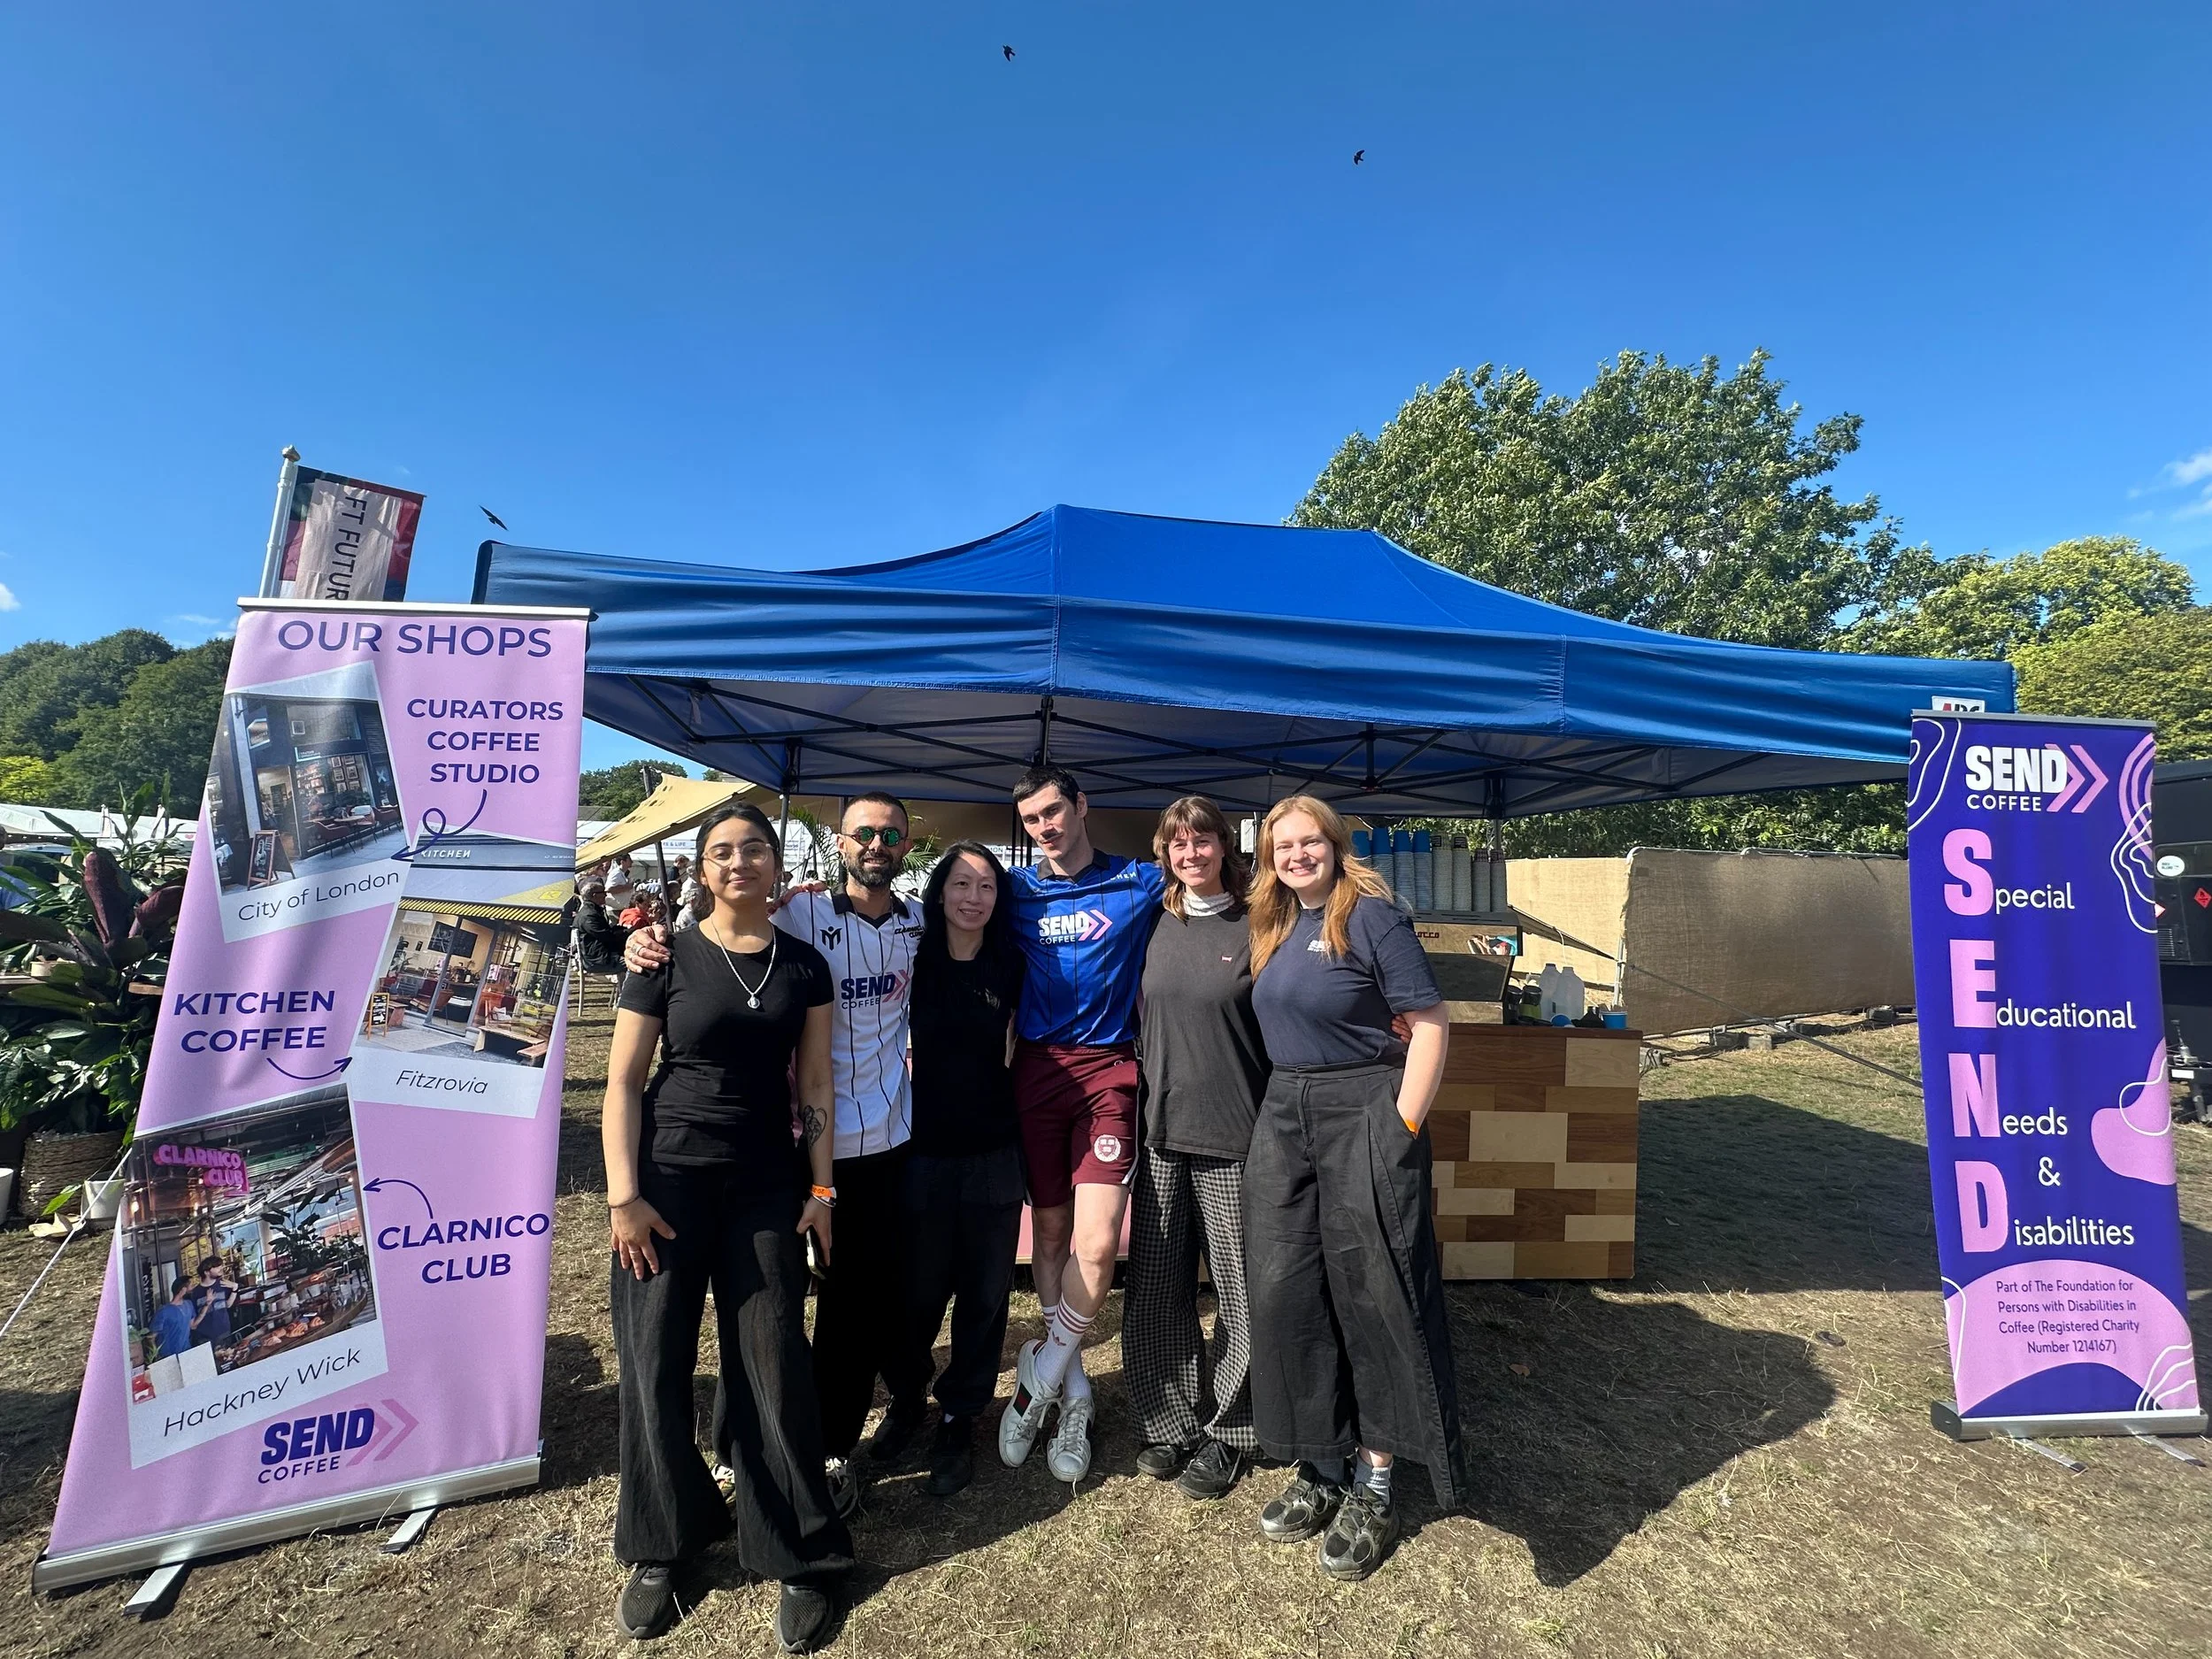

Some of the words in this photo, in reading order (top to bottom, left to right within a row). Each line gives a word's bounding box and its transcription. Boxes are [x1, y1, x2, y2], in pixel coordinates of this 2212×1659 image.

[342, 496, 367, 525] FT
[278, 620, 382, 652] OUR
[397, 624, 551, 657] SHOPS
[407, 699, 564, 720] CURATORS
[427, 731, 540, 752] COFFEE
[430, 764, 540, 783] STUDIO
[1965, 744, 2067, 793] SEND
[1967, 795, 2042, 811] COFFEE
[238, 900, 282, 921] City
[287, 888, 310, 909] of
[316, 870, 400, 903] London
[1038, 914, 1089, 936] SEND
[1040, 935, 1075, 944] COFFEE
[841, 974, 896, 1000] SEND
[174, 991, 334, 1015] KITCHEN
[841, 998, 880, 1010] COFFEE
[181, 1026, 326, 1053] COFFEE
[396, 1071, 488, 1094] Fitzrovia
[207, 1168, 243, 1187] CLUB
[2038, 1157, 2061, 1186] &
[378, 1212, 550, 1249] CLARNICO
[422, 1254, 511, 1284] CLUB
[1996, 1280, 2018, 1293] Part
[2022, 1280, 2032, 1292] of
[2035, 1279, 2054, 1292] The
[2056, 1279, 2116, 1292] Foundation
[2118, 1279, 2133, 1291] for
[1998, 1301, 2039, 1312] Persons
[2042, 1300, 2065, 1312] with
[2068, 1300, 2124, 1311] Disabilities
[2127, 1300, 2137, 1310] in
[1999, 1321, 2035, 1333] Coffee
[2038, 1319, 2100, 1335] (Registered
[2102, 1319, 2139, 1333] Charity
[2027, 1340, 2070, 1354] Number
[2072, 1340, 2117, 1354] 1214167)
[164, 1375, 289, 1437] Hackney
[296, 1348, 362, 1386] Wick
[261, 1408, 375, 1466] SEND
[257, 1455, 341, 1485] COFFEE
